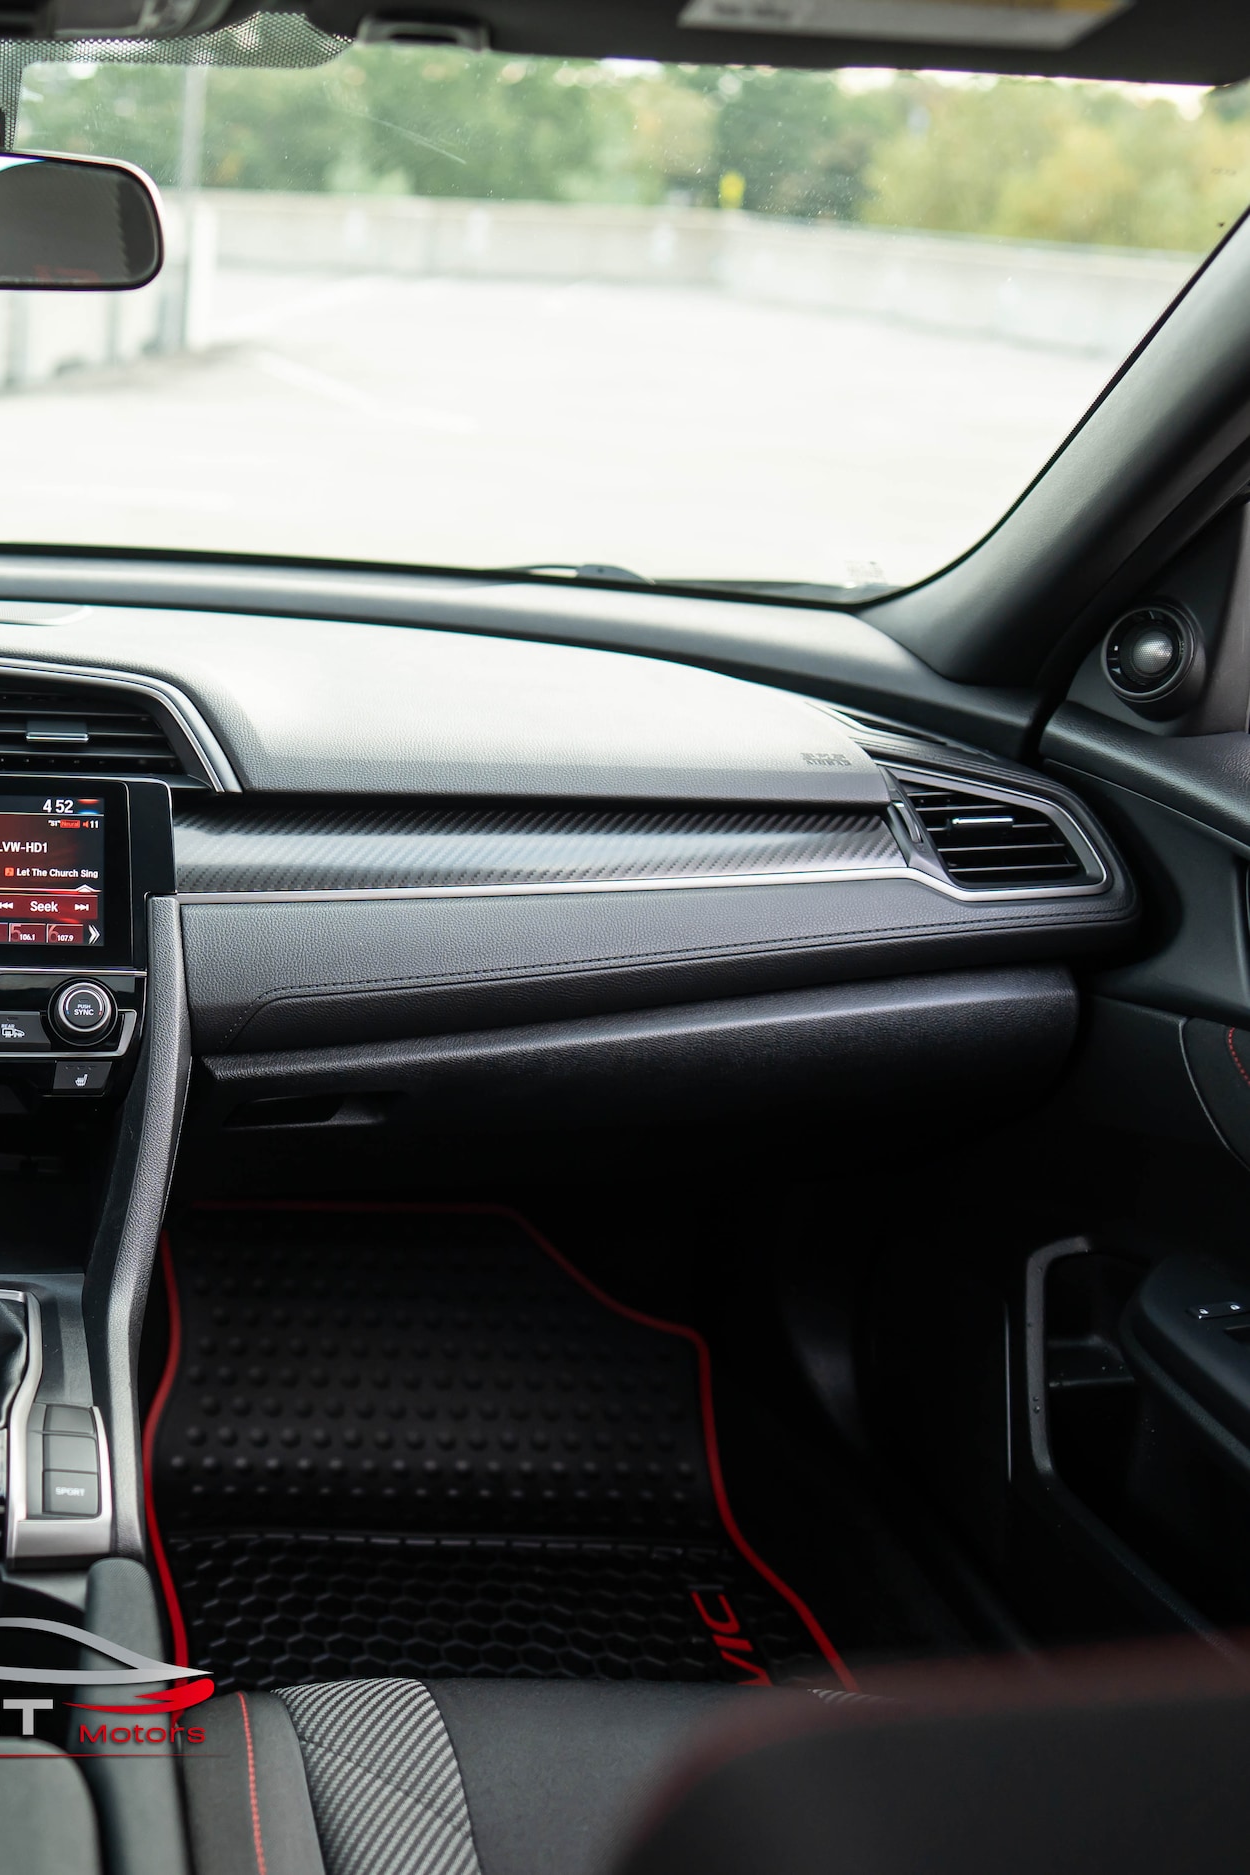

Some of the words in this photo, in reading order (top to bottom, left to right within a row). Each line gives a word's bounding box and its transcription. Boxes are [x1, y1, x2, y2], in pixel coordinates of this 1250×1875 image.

[16, 868, 30, 877] Let
[32, 868, 47, 877] The
[49, 868, 79, 878] Church
[80, 870, 99, 879] Sing
[30, 901, 59, 912] Seek
[55, 1486, 86, 1497] SPORT
